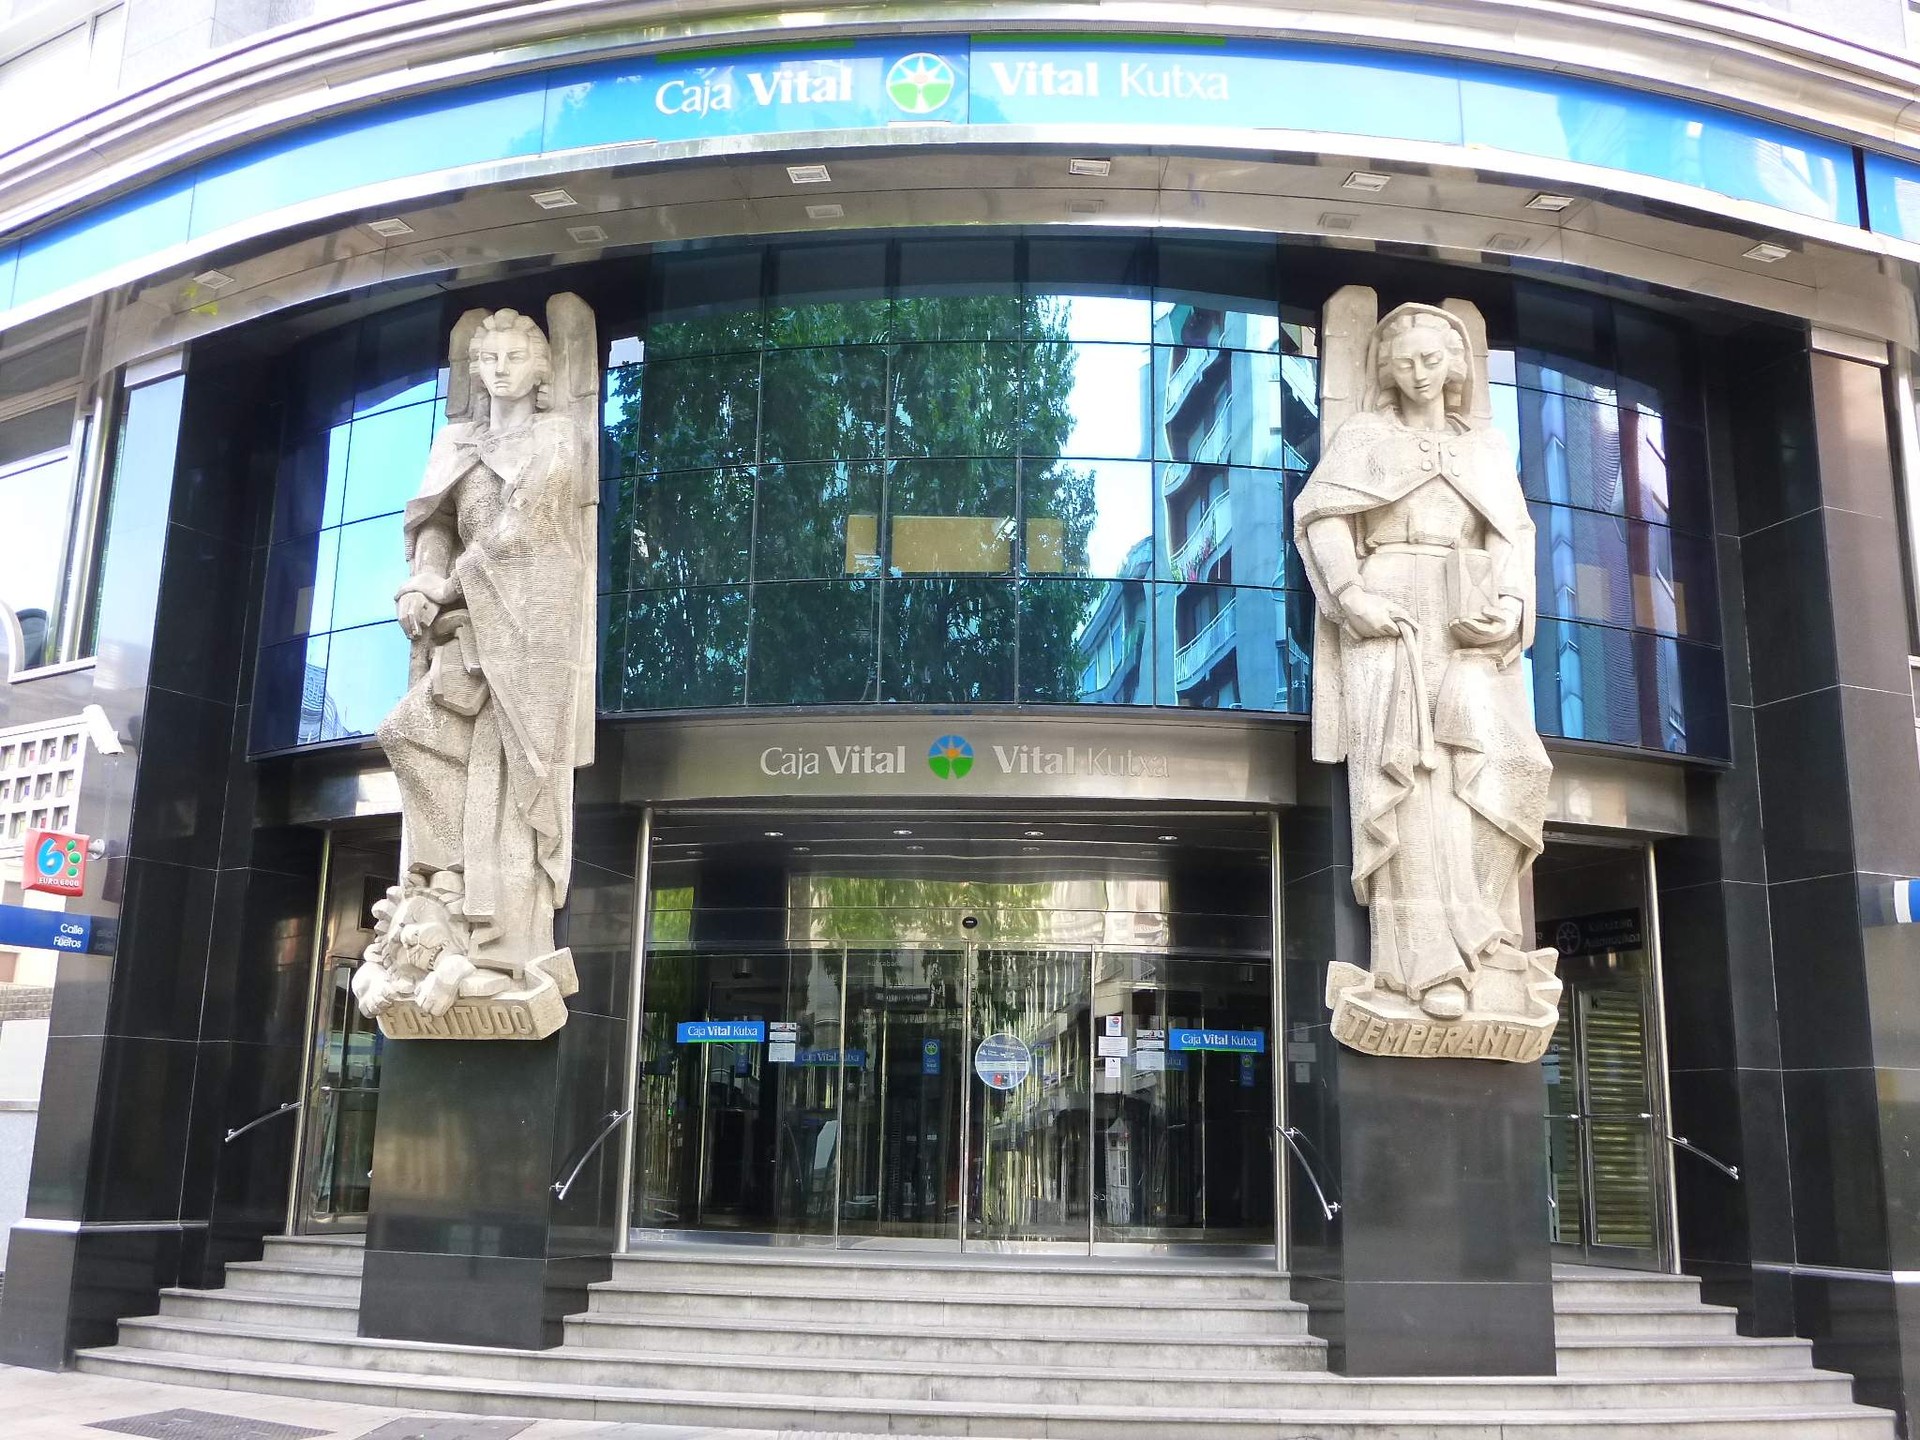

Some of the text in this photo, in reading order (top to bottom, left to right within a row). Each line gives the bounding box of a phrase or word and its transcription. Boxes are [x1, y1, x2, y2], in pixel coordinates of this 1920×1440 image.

[655, 68, 851, 119] Caja Vital
[989, 61, 1230, 100] Vital Kutxa
[760, 745, 906, 780] Caja Vital
[992, 745, 1170, 778] Vital Kutxa
[53, 935, 82, 948] Fueros
[60, 923, 84, 935] Calle
[687, 1025, 758, 1038] Caja Vital Kutxa
[1181, 1034, 1257, 1046] Caja Vital Kutxa
[1345, 1010, 1544, 1059] TEMPERANTIA
